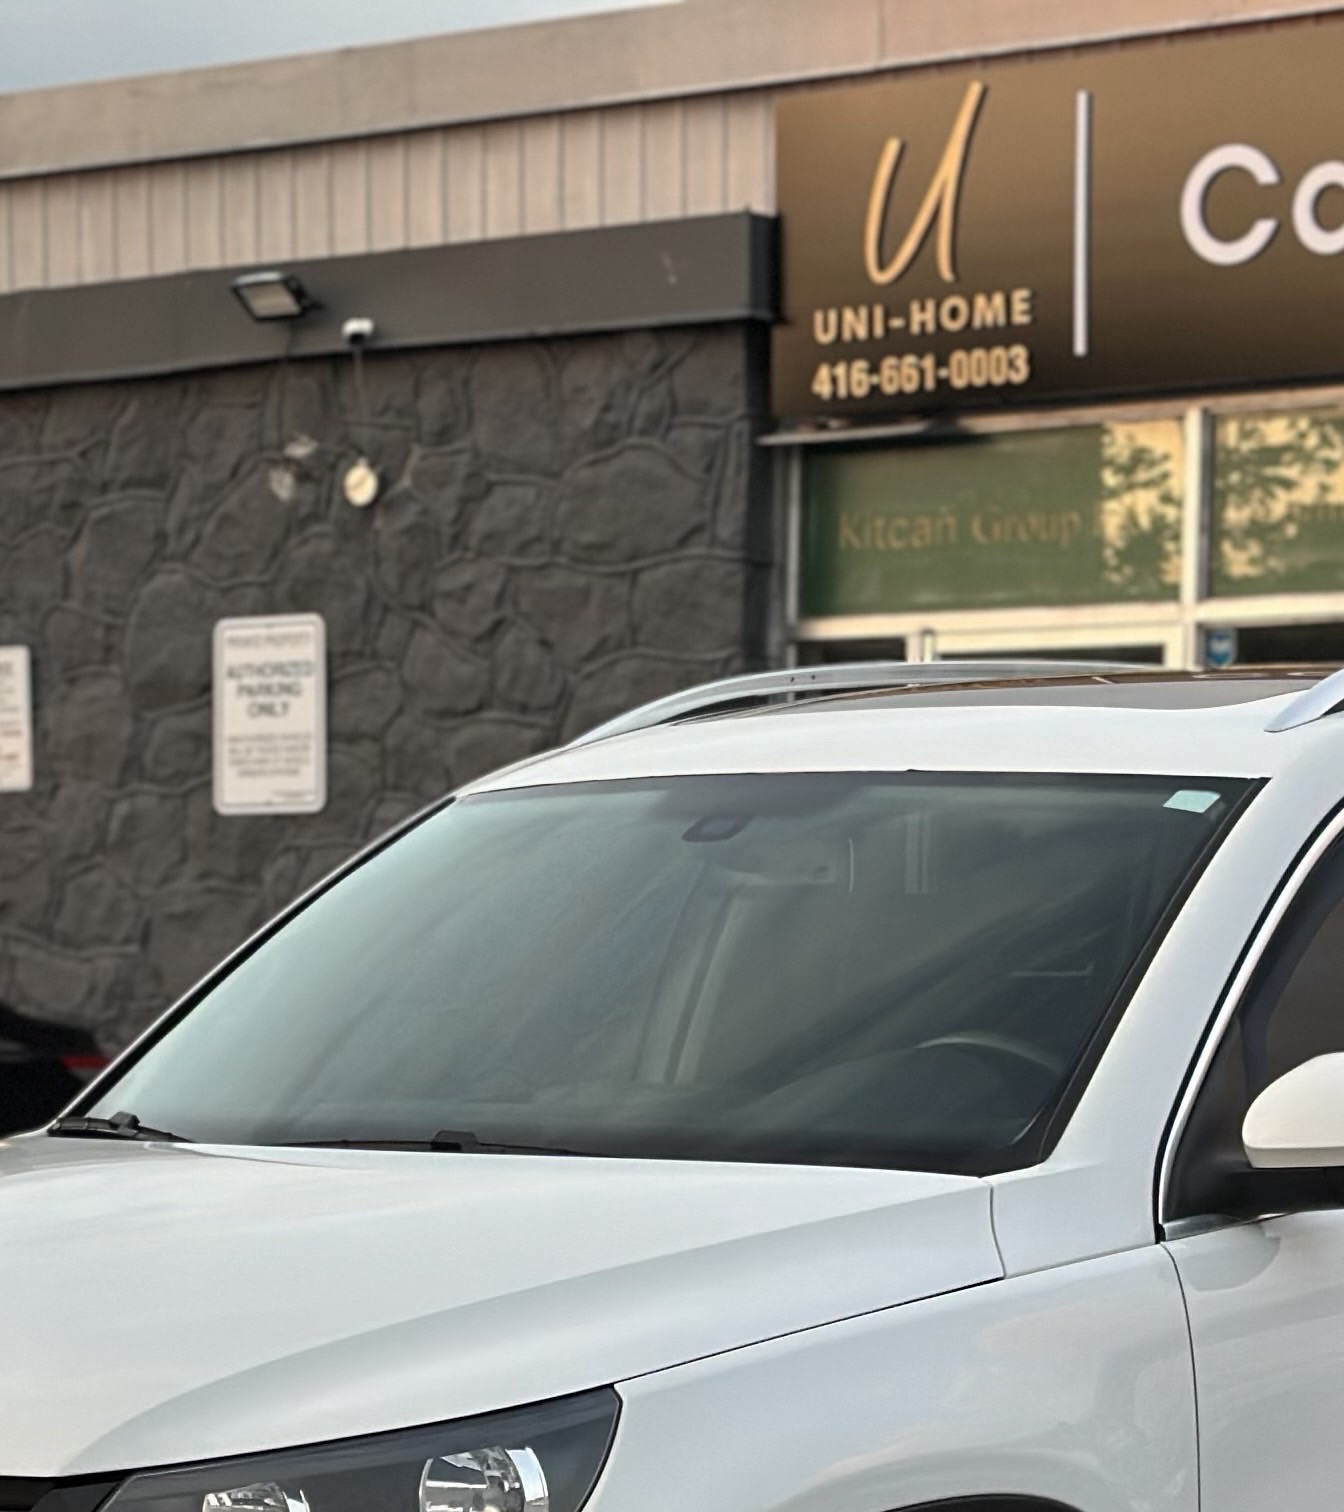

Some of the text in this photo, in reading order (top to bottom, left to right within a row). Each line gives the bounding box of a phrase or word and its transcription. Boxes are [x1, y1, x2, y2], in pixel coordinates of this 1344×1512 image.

[813, 290, 1033, 345] UNI-HOME
[811, 344, 1029, 401] 416-661-0003
[837, 510, 958, 552] Kitcan
[971, 508, 1081, 549] Group
[236, 680, 303, 700] PARKING
[246, 700, 291, 719] ONLY
